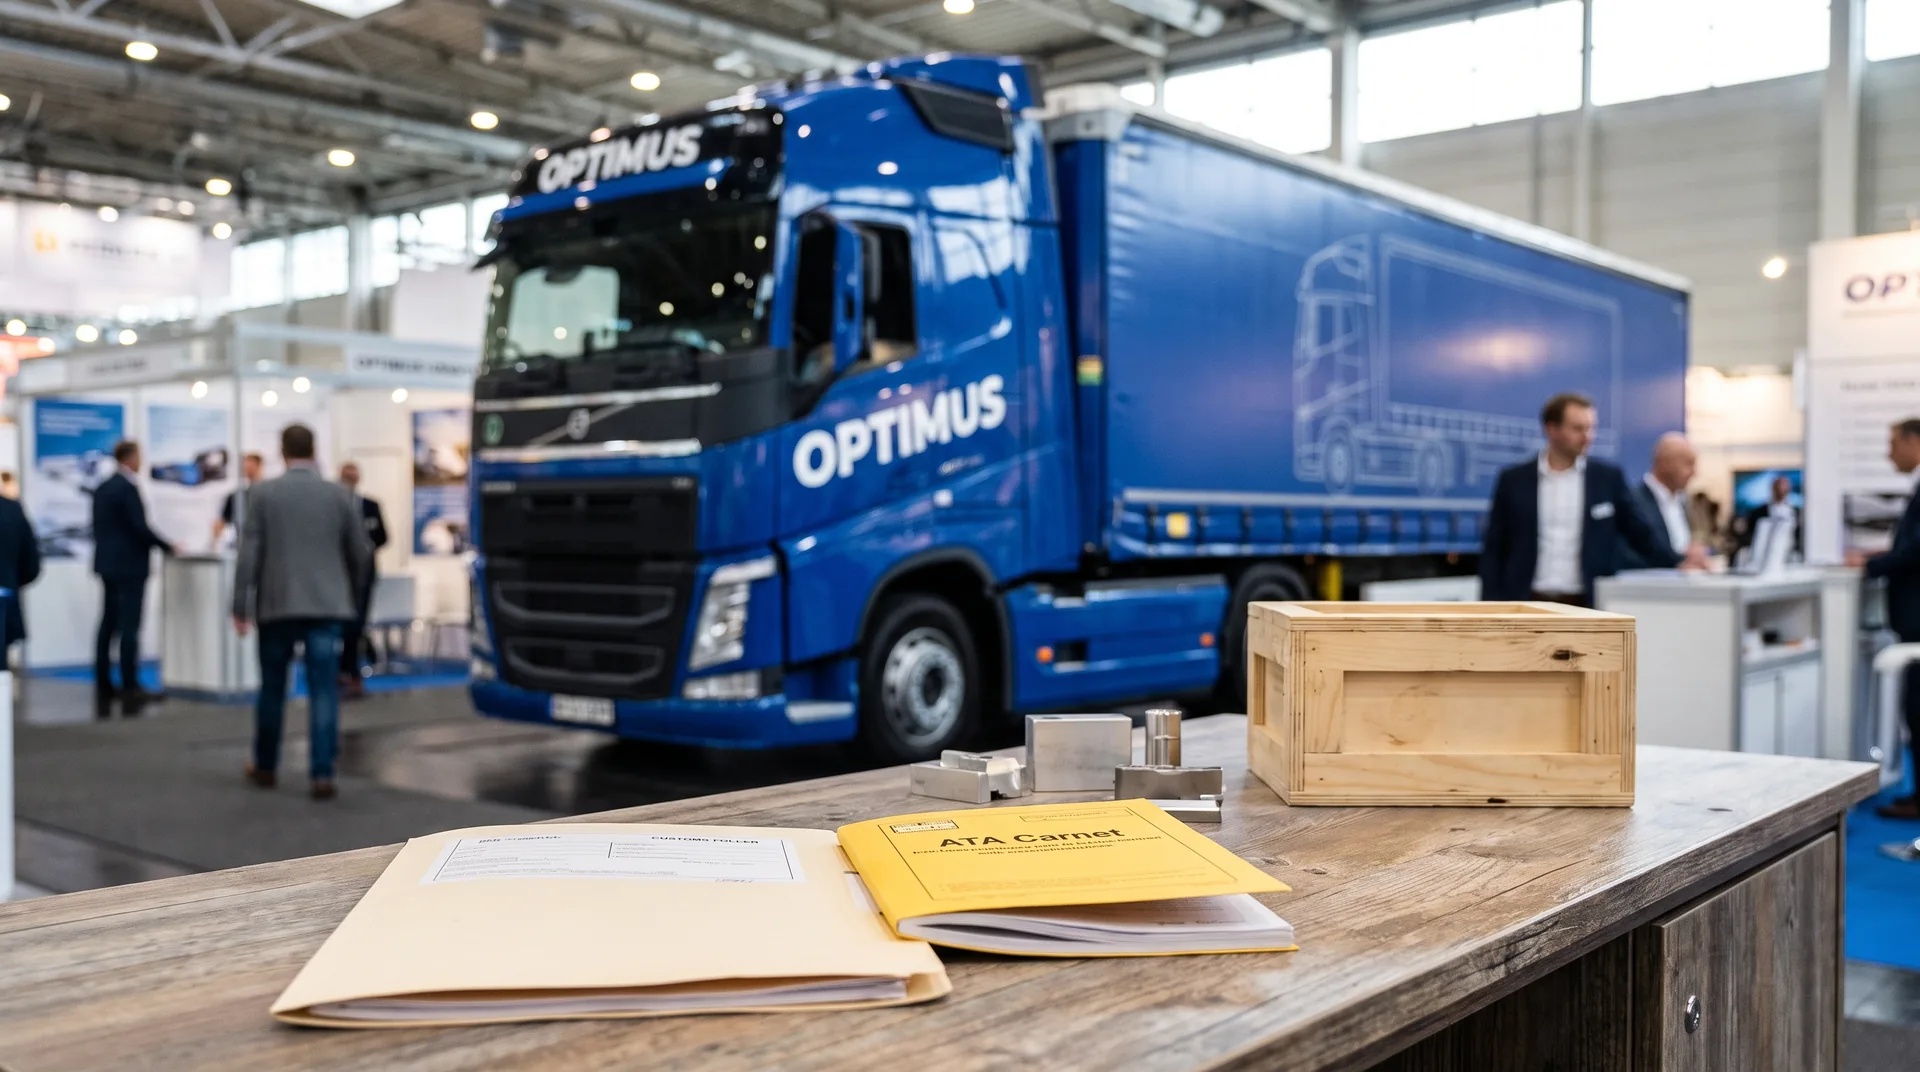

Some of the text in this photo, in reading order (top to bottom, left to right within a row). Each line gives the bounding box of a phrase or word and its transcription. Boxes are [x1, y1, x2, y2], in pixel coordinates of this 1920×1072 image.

[538, 124, 703, 194] OPTIMUS
[1844, 272, 1920, 303] OP
[792, 374, 1007, 489] OPTIMUS
[940, 836, 1006, 847] ATA
[1013, 829, 1125, 843] Carnet
